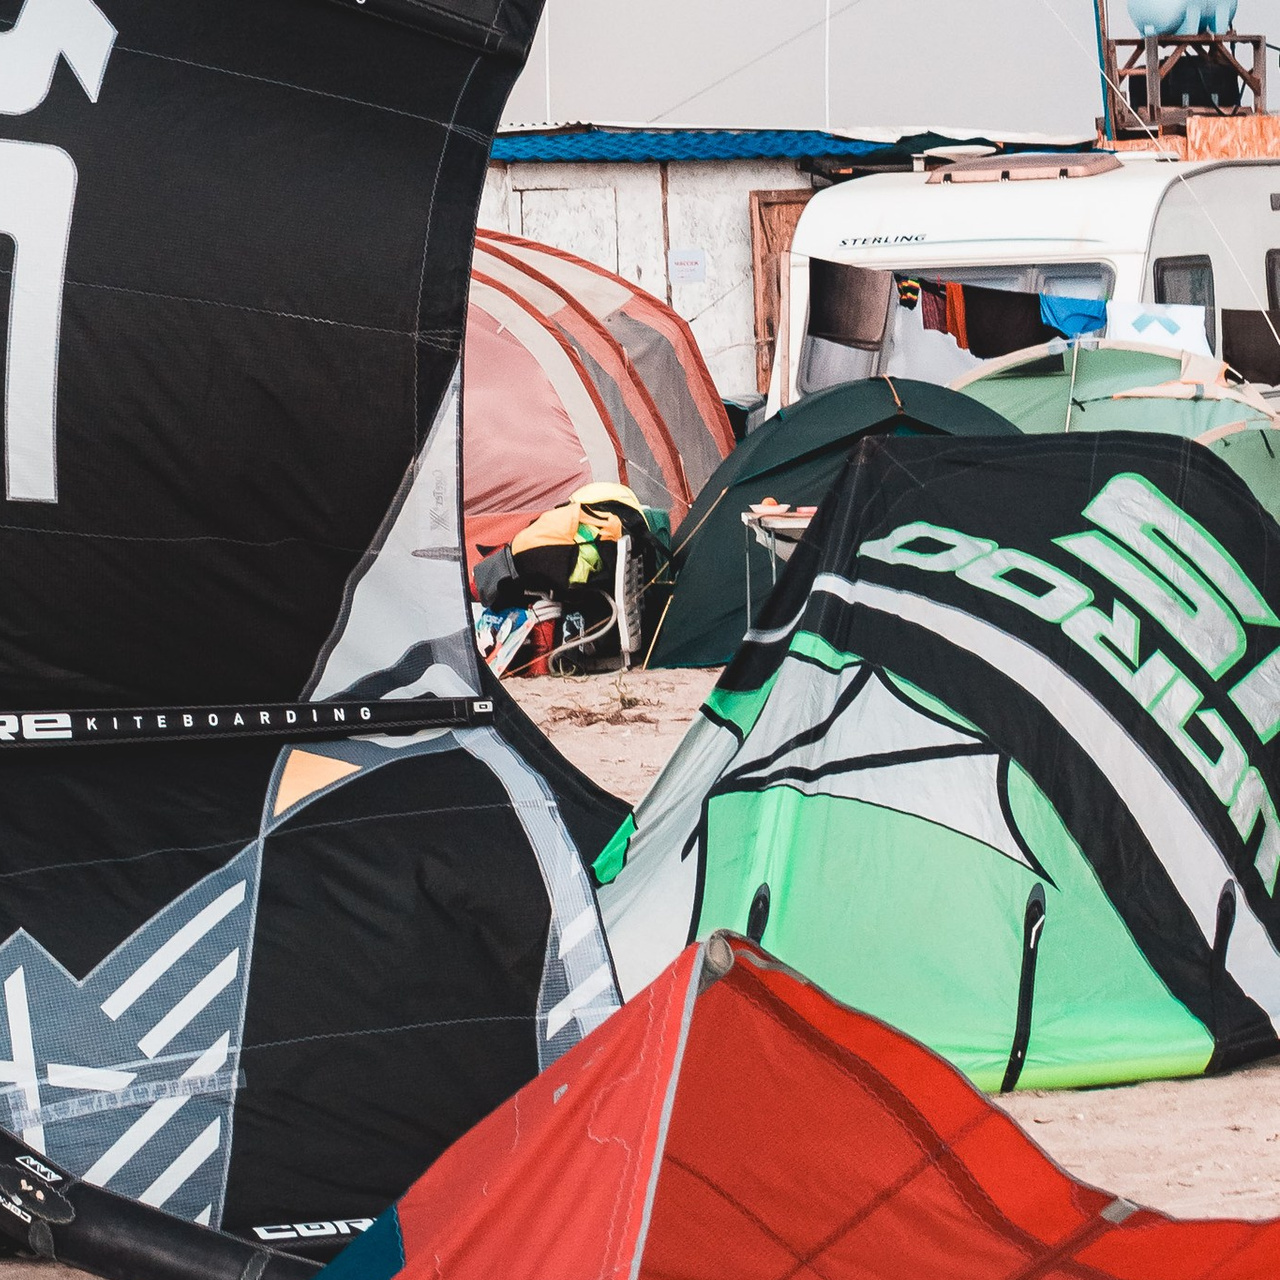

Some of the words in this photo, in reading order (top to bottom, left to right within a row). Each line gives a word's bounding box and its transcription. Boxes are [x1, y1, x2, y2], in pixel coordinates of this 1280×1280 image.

[838, 233, 927, 247] STERLING
[86, 706, 371, 731] KITEBOARDING
[252, 1217, 377, 1240] COR
